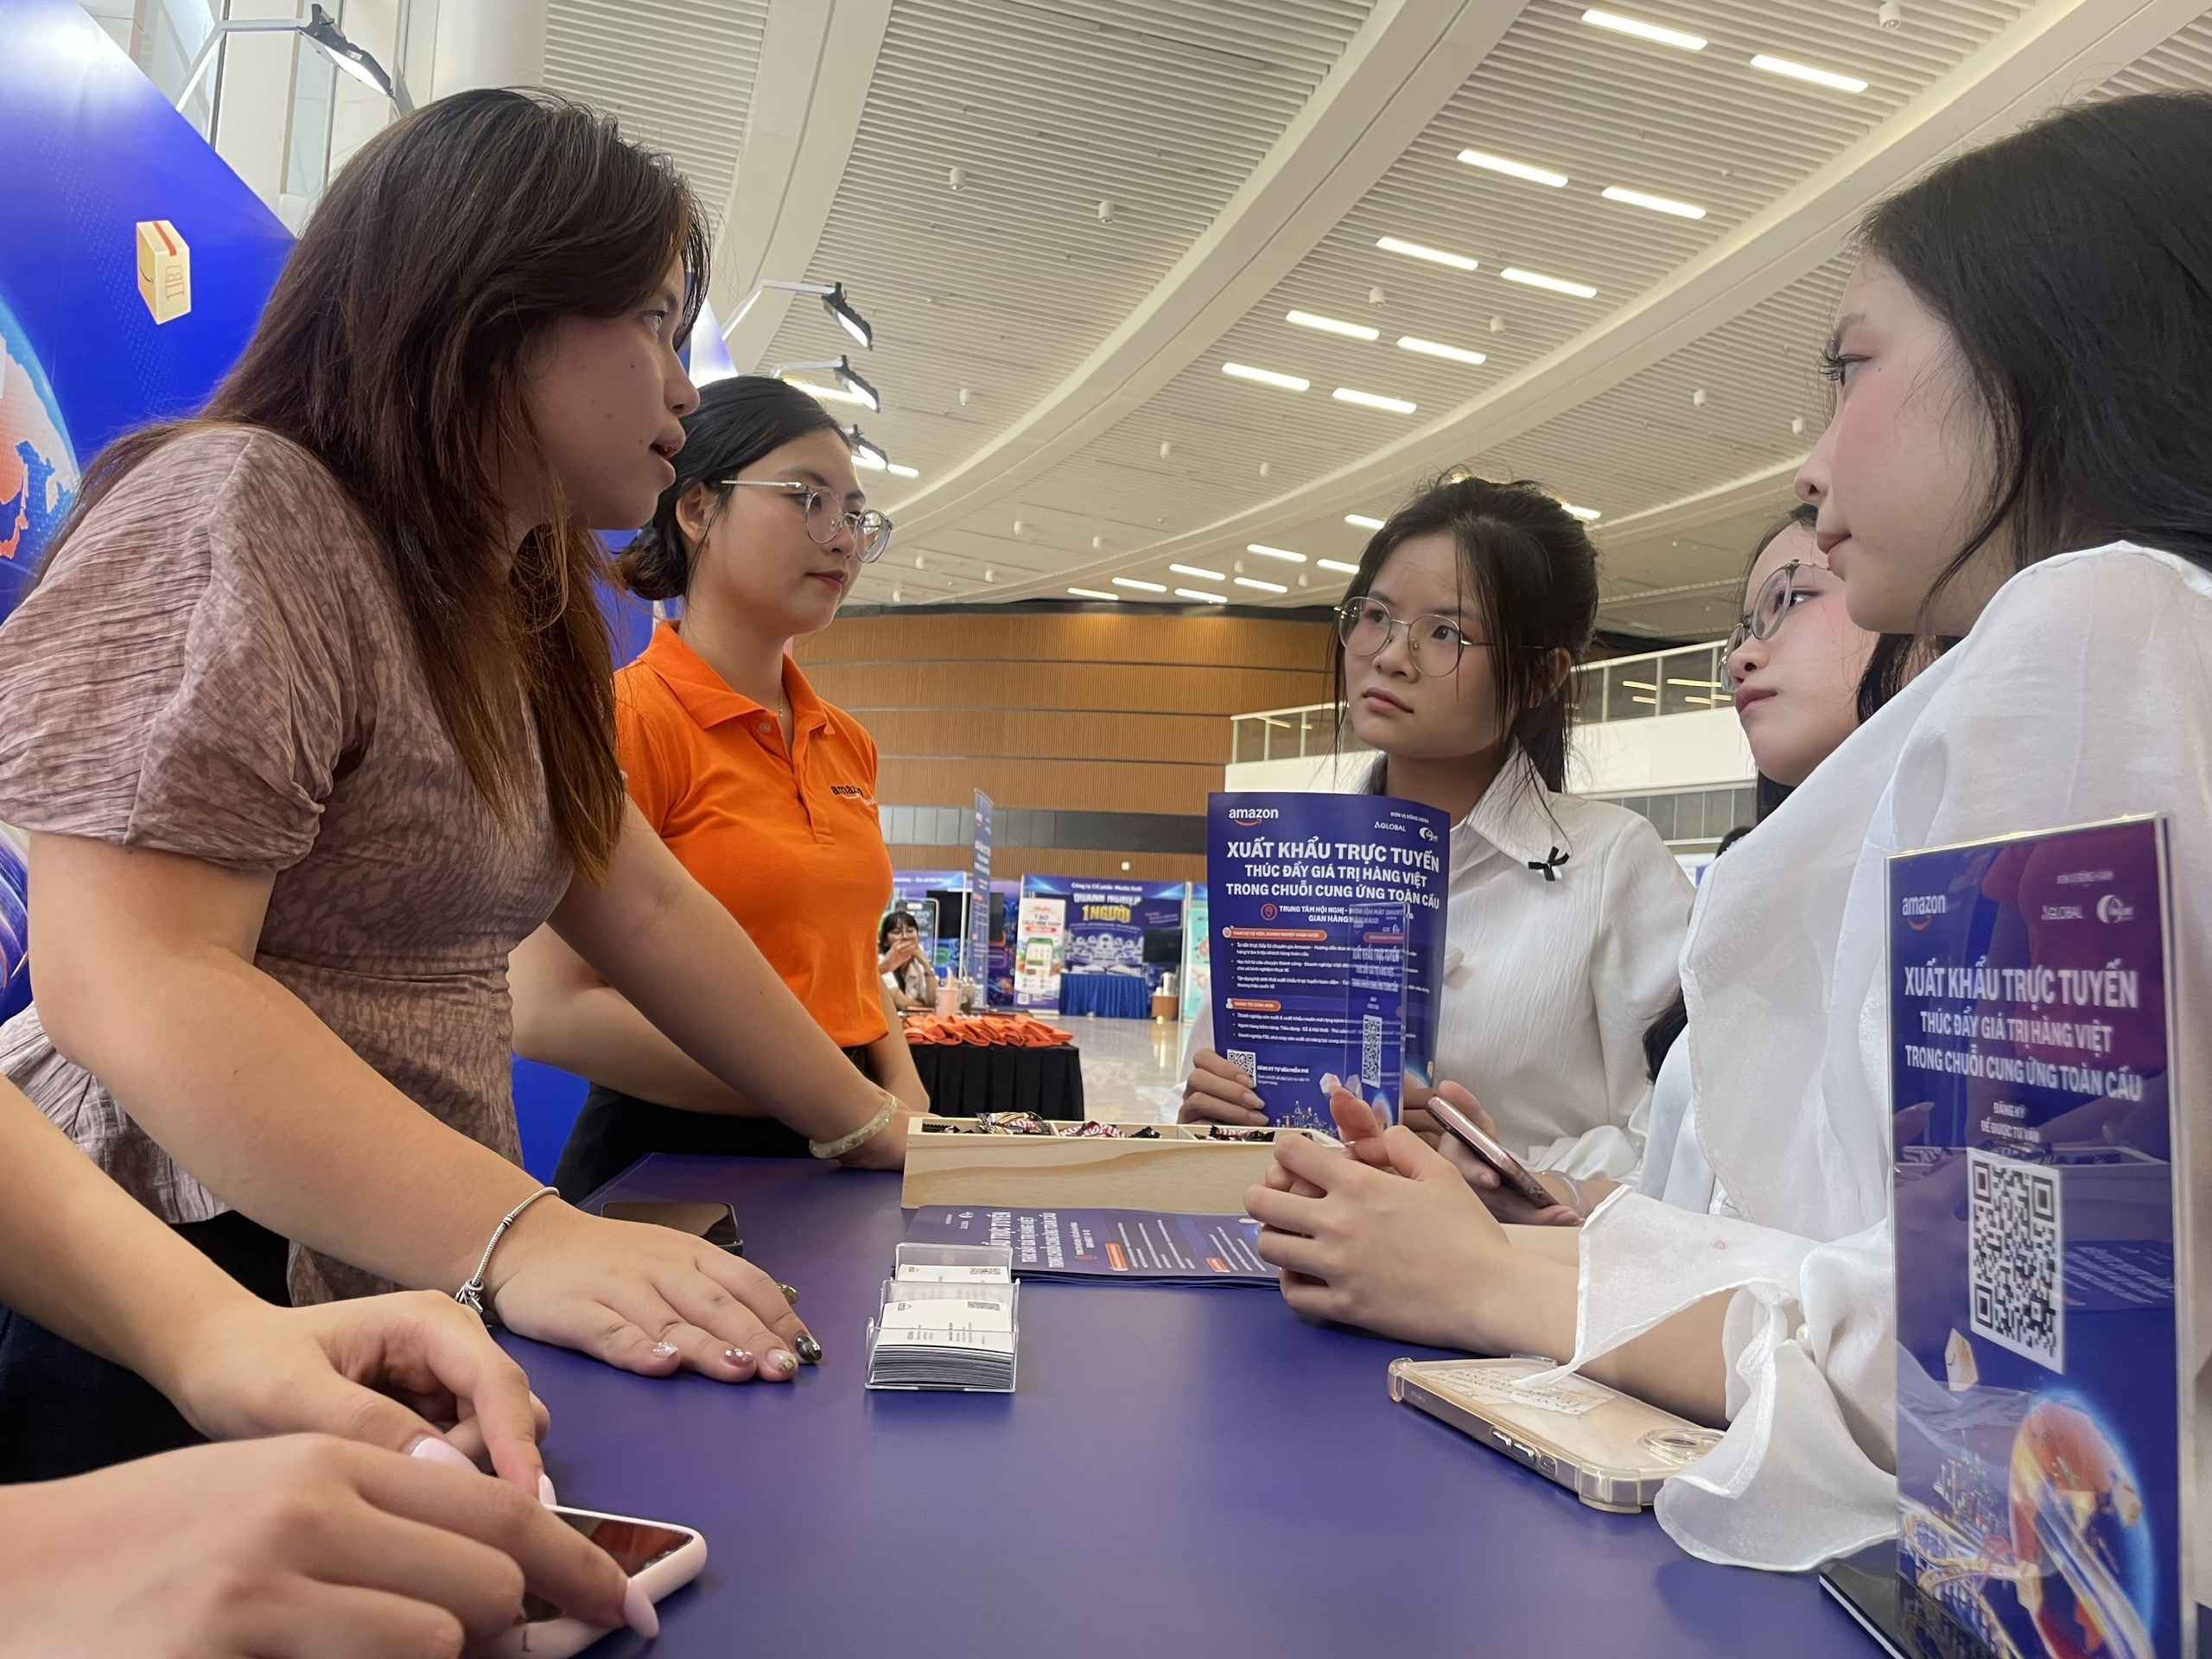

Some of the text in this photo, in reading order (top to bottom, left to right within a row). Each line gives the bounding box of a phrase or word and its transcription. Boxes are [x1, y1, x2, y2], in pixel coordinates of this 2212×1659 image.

[1229, 809, 1279, 819] amazon
[1227, 836, 1440, 873] XUẤT KHẨU TRỰC TUYẾN
[1245, 861, 1427, 887] THÚC ĐẨY GIÁ TRỊ HÀNG VIỆT
[1226, 880, 1440, 909] TRONG CHUỖI CUNG ỨNG TOÀN CẦU
[1902, 894, 1946, 917] amazon
[1316, 906, 1327, 914] HỘI
[1327, 914, 1348, 923] HÀNG
[1904, 955, 2139, 1011] XUẤT KHẨU TRỰC TUYẾN
[1920, 1006, 2113, 1058] THÚC ĐẨY GIÁ TRỊ HÀNG VIỆT
[1905, 1044, 2143, 1102] TRONG CHUỖI CUNG ỨNG TOÀN CẦU
